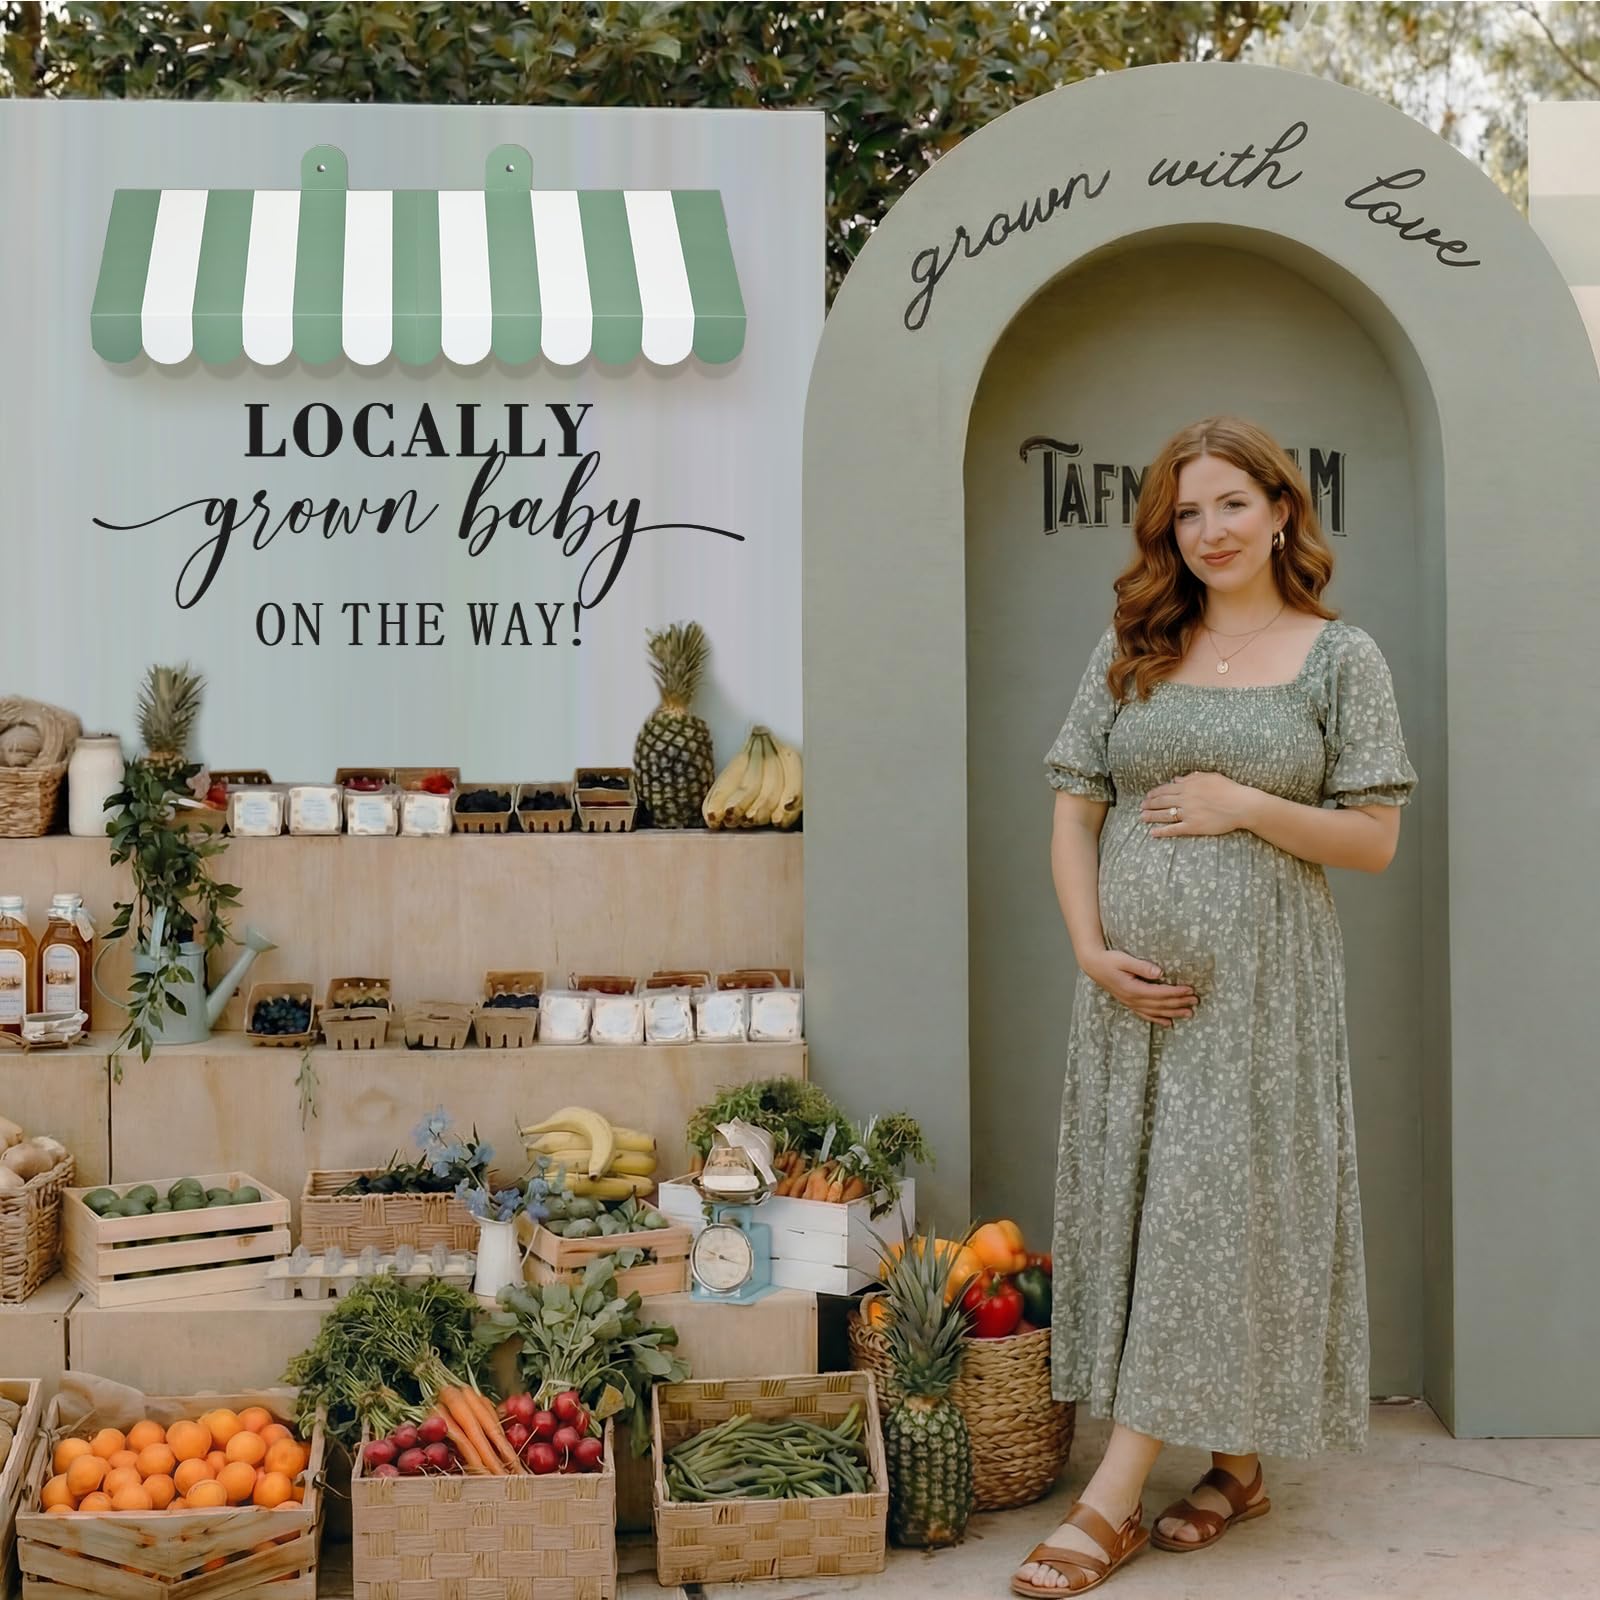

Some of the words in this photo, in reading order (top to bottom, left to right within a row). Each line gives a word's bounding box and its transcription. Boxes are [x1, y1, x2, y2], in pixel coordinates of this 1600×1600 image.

[904, 168, 1111, 331] grown
[1147, 121, 1309, 190] with
[1344, 168, 1481, 267] love
[245, 402, 594, 458] LOCALLY
[92, 489, 440, 610] grown
[458, 451, 745, 610] baby
[255, 602, 325, 647] ON
[341, 602, 446, 647] THE
[466, 602, 583, 647] WAY!
